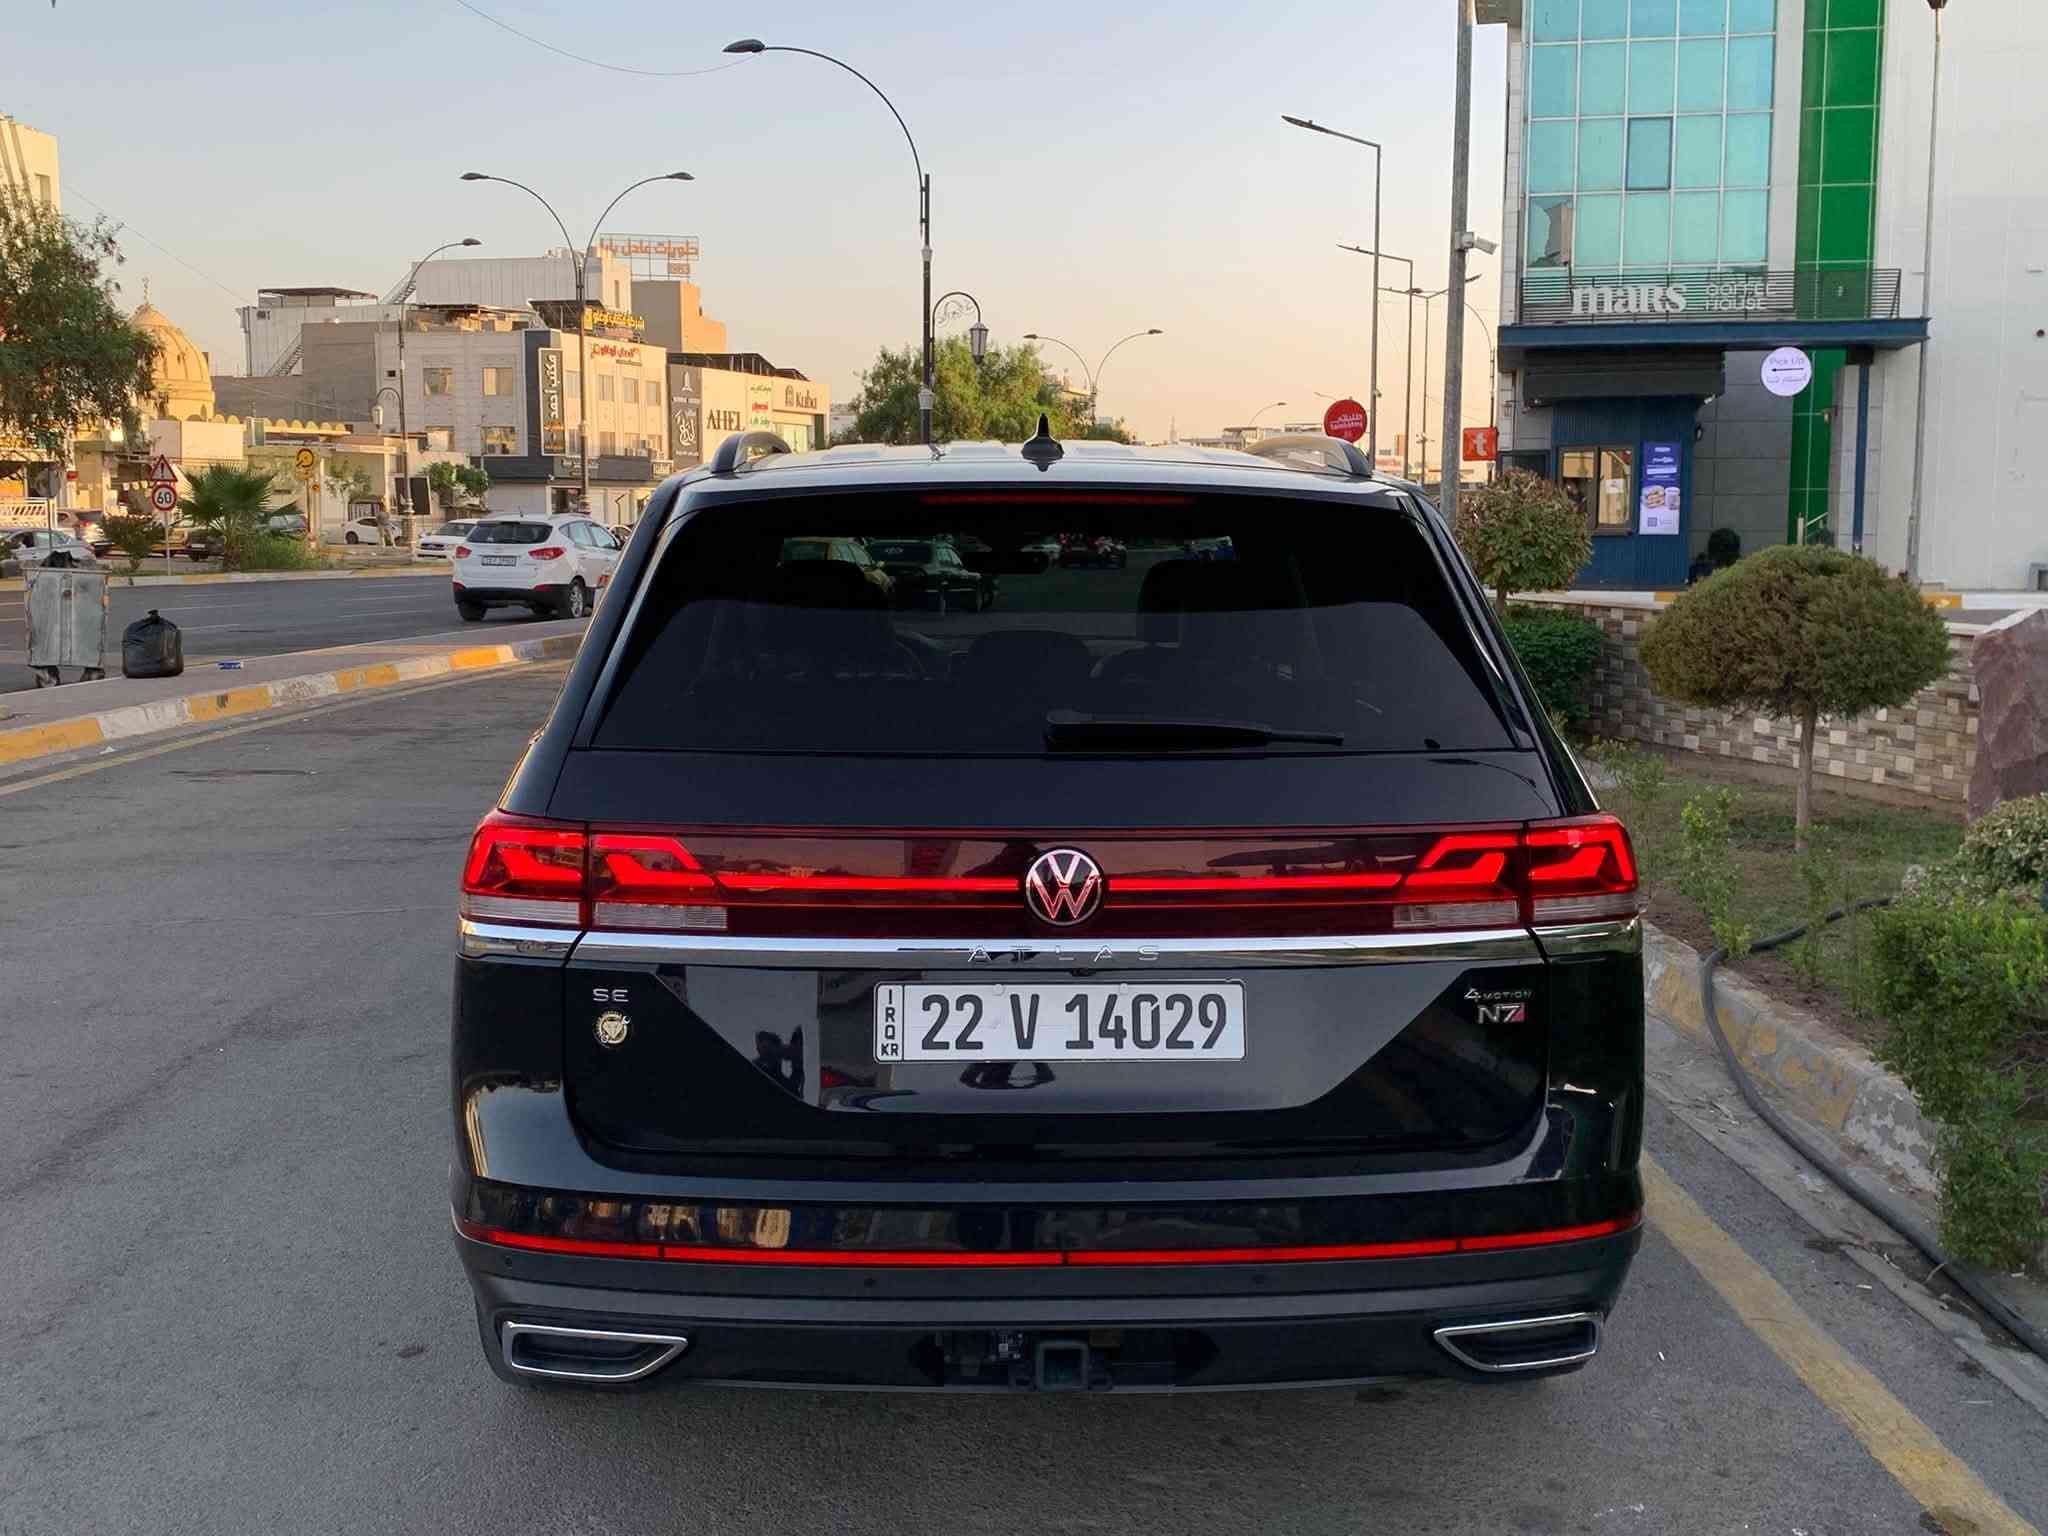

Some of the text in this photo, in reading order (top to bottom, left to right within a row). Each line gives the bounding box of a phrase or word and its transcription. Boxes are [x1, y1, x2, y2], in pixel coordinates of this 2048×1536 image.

[1706, 282, 1775, 297] COFFEE
[1705, 297, 1768, 311] HOUSE
[544, 354, 561, 388] مكتب
[156, 491, 171, 504] 60
[967, 943, 1160, 963] ATLAS
[593, 988, 629, 1002] SE
[921, 993, 1228, 1051] 22 V 14029
[880, 1042, 899, 1057] KR
